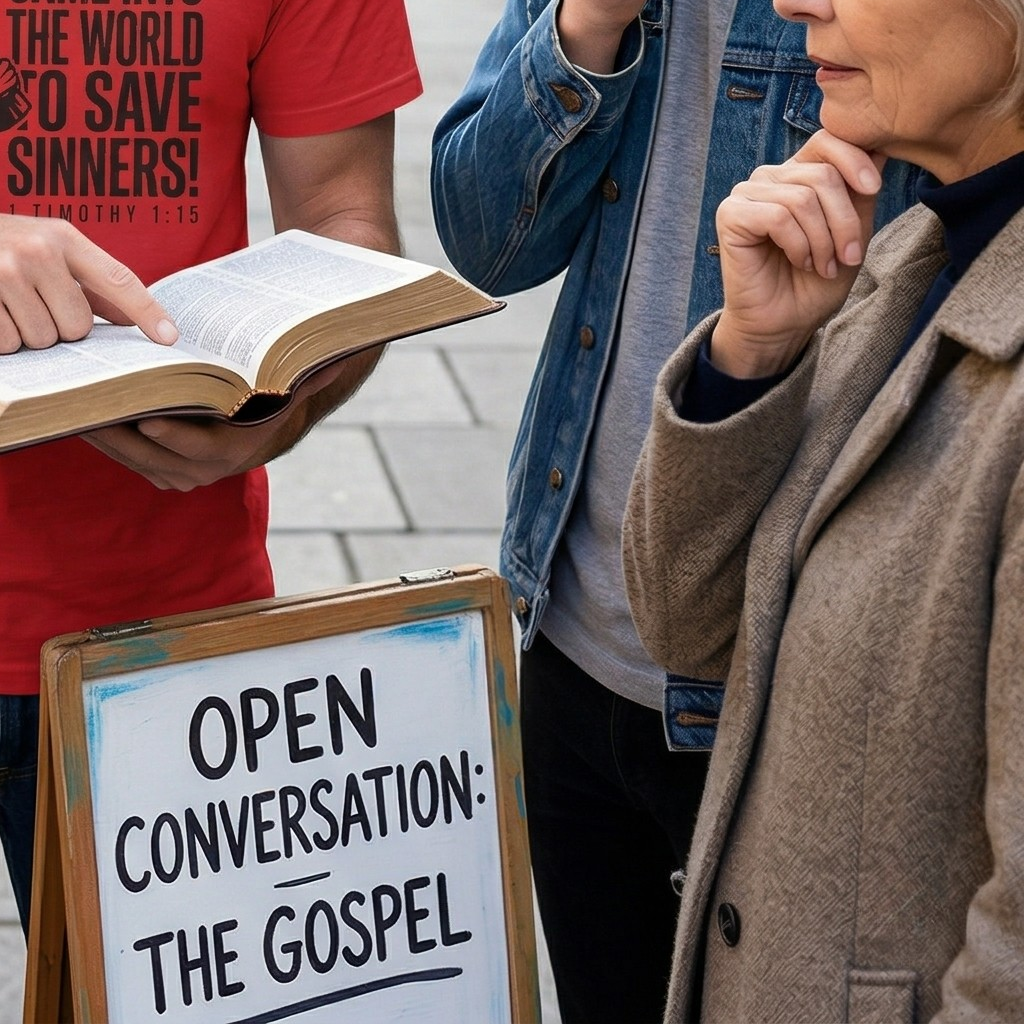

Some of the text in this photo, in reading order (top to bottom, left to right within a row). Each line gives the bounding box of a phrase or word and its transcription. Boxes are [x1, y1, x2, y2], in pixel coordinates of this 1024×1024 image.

[6, 9, 204, 66] THE WORLD
[84, 70, 202, 132] SAVE
[7, 136, 200, 198] SINNERS!
[33, 204, 136, 224] TIMOTHY
[152, 205, 199, 224] 1:15
[189, 667, 377, 780] OPEN
[115, 750, 487, 893] CONVERSATION:
[133, 873, 472, 1014] THE GOSPEL
